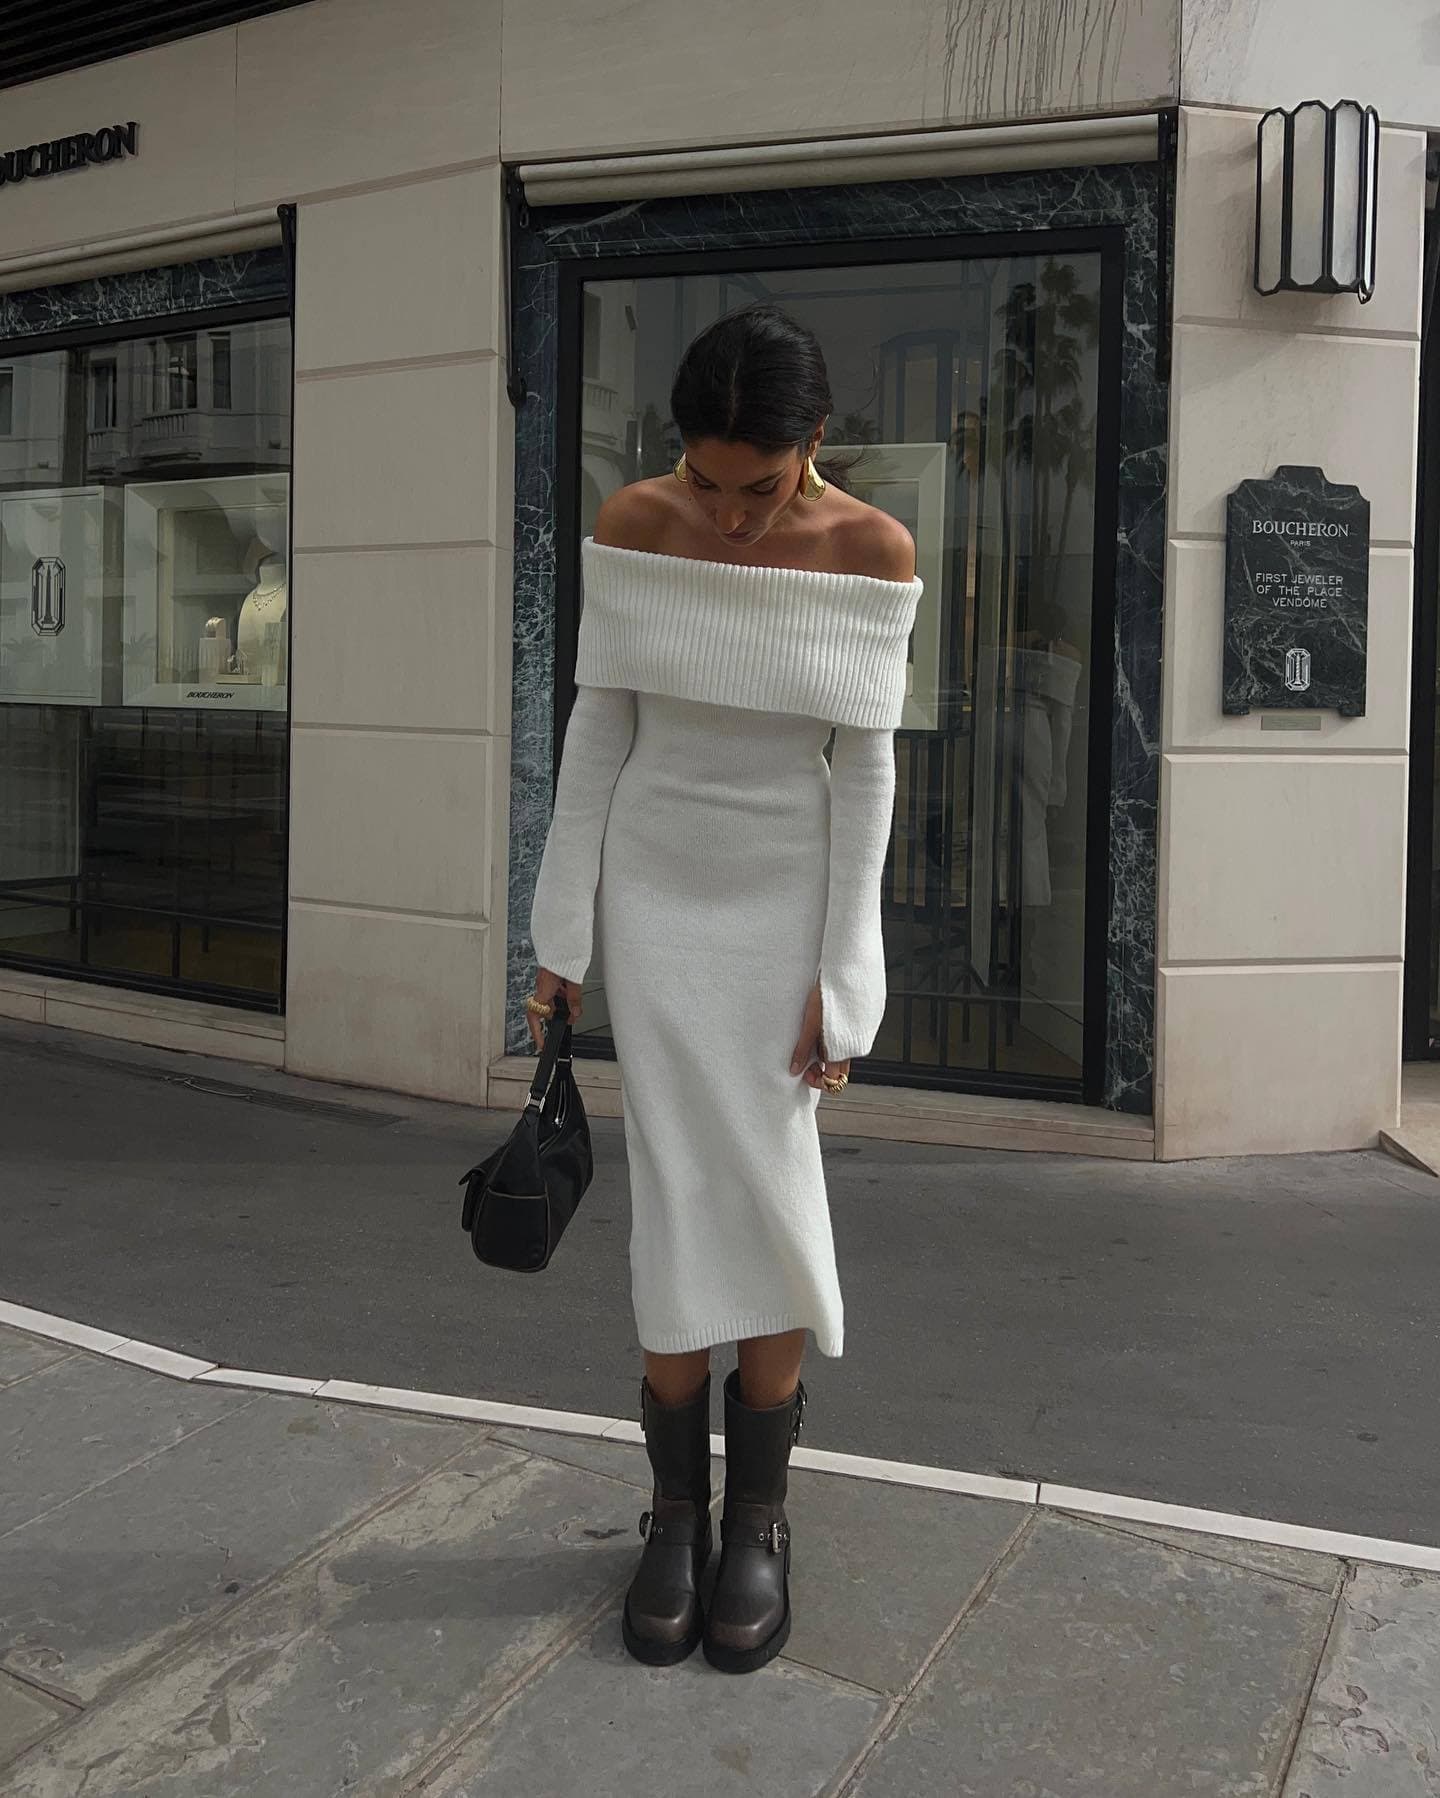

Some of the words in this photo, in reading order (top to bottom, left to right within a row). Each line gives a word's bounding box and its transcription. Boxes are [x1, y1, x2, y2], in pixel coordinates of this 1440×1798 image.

[0, 121, 137, 186] UCHERON
[1252, 520, 1350, 538] BOUCHERON
[1255, 572, 1288, 584] FIRST
[1291, 574, 1344, 586] JEWELER
[1256, 585, 1272, 595] OF
[1279, 585, 1300, 596] THE
[1307, 586, 1343, 597] PLACE
[1272, 596, 1328, 609] VENDÔME
[186, 691, 235, 699] BOUCHERON
